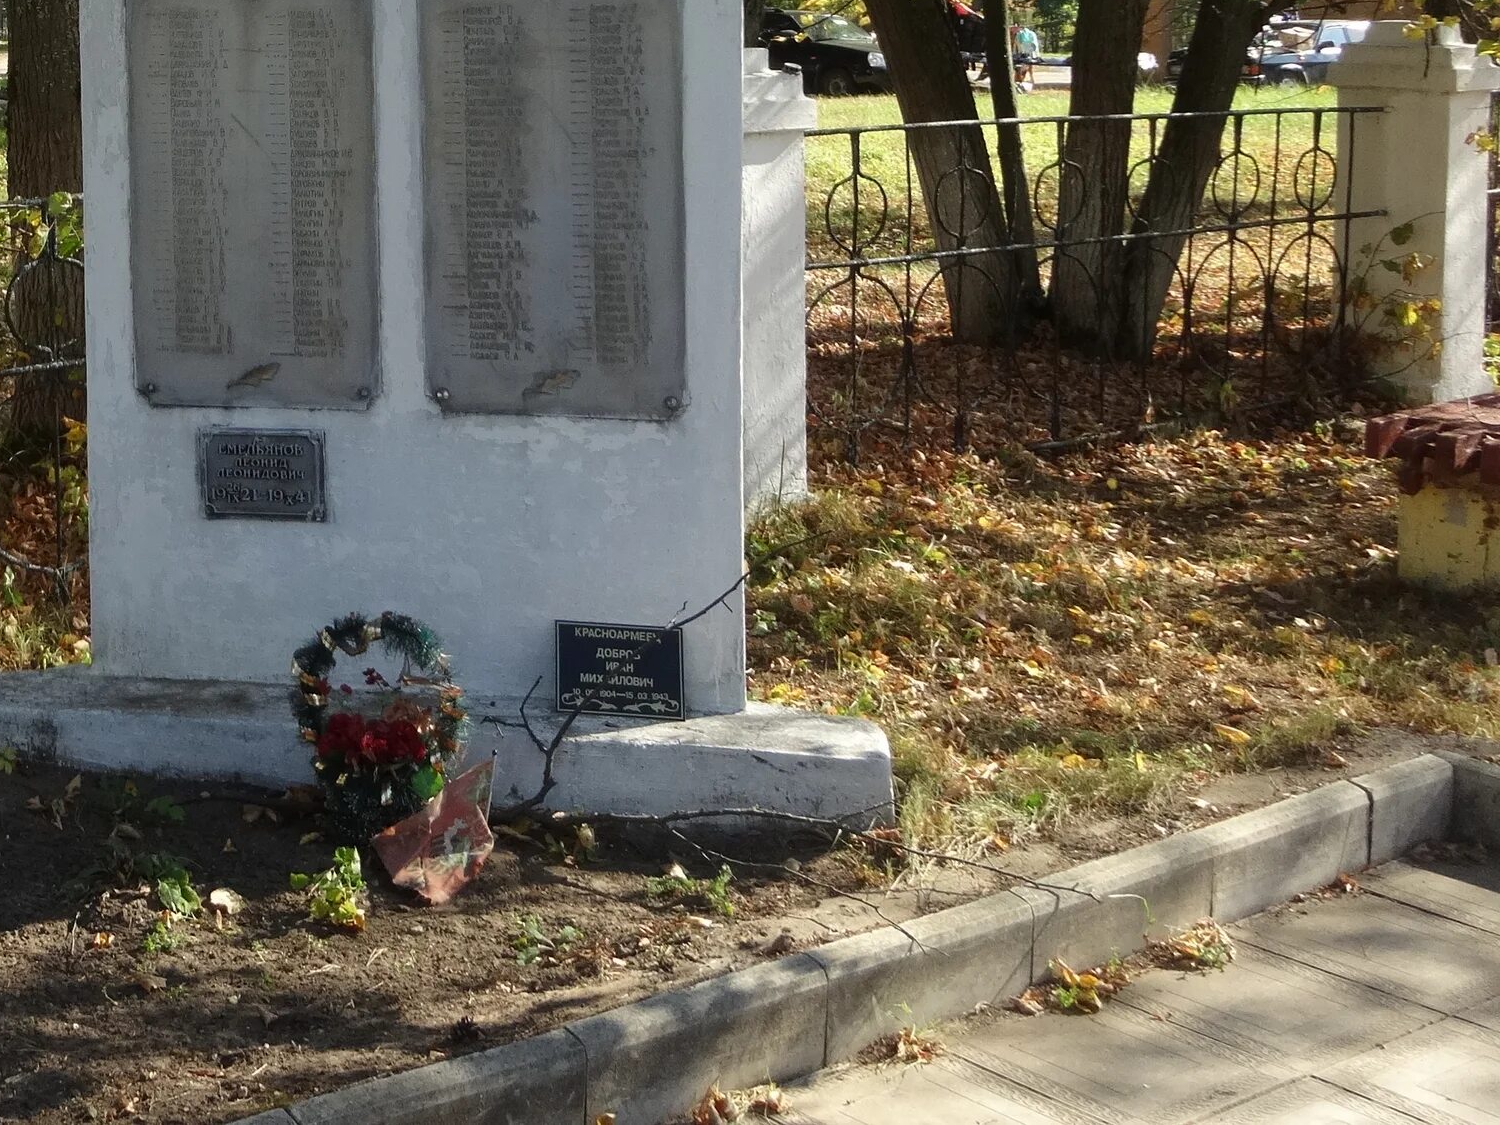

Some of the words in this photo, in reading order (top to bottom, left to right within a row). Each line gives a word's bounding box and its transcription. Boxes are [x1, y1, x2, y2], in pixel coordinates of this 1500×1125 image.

[218, 442, 304, 456] ЕМЕЛЬЯНОВ
[234, 458, 288, 469] ЛЕОНИД
[217, 469, 305, 481] ЛЕОНИДОВИЧ
[580, 673, 654, 688] МИХИЛОВИЧ
